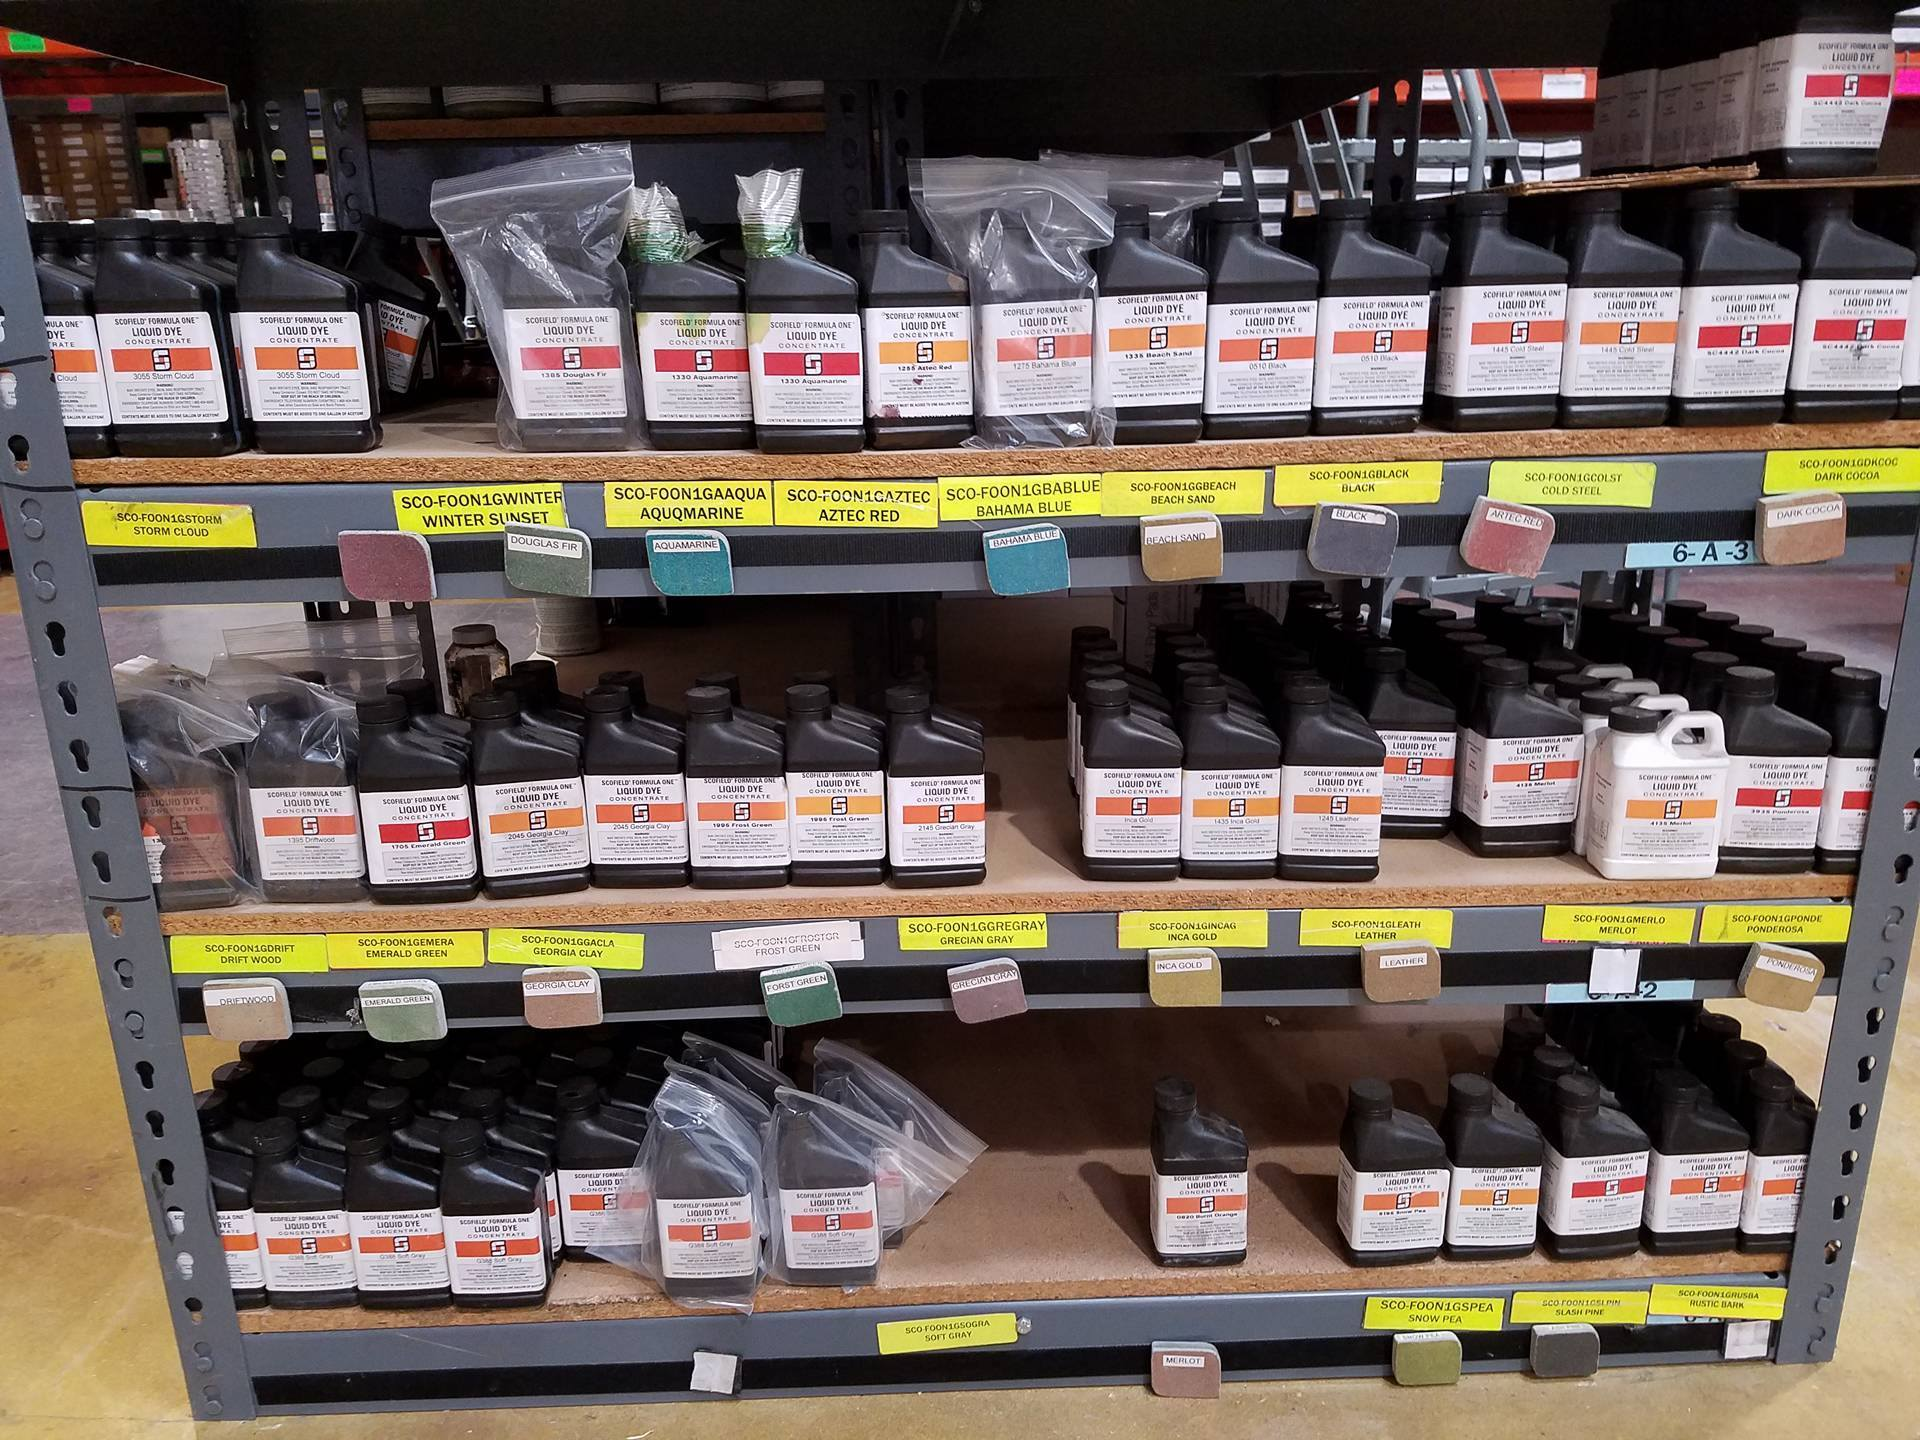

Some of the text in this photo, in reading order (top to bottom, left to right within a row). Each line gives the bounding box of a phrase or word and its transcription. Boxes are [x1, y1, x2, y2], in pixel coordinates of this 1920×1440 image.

[1133, 304, 1184, 316] LIQUID DYE
[1497, 300, 1546, 310] LIQUID DYE
[294, 316, 326, 324] FORMULA
[1358, 310, 1409, 321] LIQUID DYE
[900, 321, 947, 331] LIQUID DYE
[1019, 317, 1068, 328] LIQUID DYE
[131, 326, 182, 337] LIQUID DYE
[277, 326, 329, 337] LIQUID DYE
[676, 328, 727, 338] LIQUID DYE
[786, 331, 837, 341] LIQUID DYE
[269, 337, 336, 345] CONCENTRATE
[296, 372, 318, 380] Storm
[319, 372, 341, 380] Cloud
[1813, 470, 1881, 482] DARK COCOA
[1341, 482, 1376, 493] BLACK
[1541, 485, 1603, 496] COLD STEEL
[1150, 494, 1216, 506] BEACH SAND
[640, 506, 744, 521] AQUQMARINE
[976, 500, 1073, 516] BAHAMA BLUE
[1776, 505, 1841, 521] DARK COCOA
[423, 511, 549, 529] WINTER SUNSET
[818, 508, 900, 523] AZTEC RED
[1335, 509, 1367, 521] BLACK
[1523, 516, 1543, 528] RED
[133, 526, 209, 538] STORM CLOUD
[510, 535, 579, 552] DOUGLAS FIR
[992, 530, 1059, 547] BAHAMA BLUE
[1145, 532, 1206, 546] BEACH SAND
[653, 539, 718, 551] AQUAMARINE
[1701, 543, 1720, 562] A
[1215, 781, 1260, 791] LIQUID DYE
[1317, 778, 1364, 788] LIQUID DYE
[1652, 782, 1698, 791] LIQUID DYE
[616, 786, 663, 796] LIQUID DYE
[923, 787, 969, 797] LIQUID DYE
[283, 798, 330, 808] LIQUID DYE
[511, 792, 560, 804] LIQUID DYE
[397, 803, 448, 814] LIQUID DYE
[630, 823, 655, 831] Georgia
[656, 823, 671, 831] Clay
[411, 842, 442, 850] Emerald
[1599, 925, 1637, 936] MERLOT
[1746, 925, 1804, 934] PONDEROSA
[940, 935, 1014, 946] GRECIAN GRAY
[1167, 931, 1218, 942] INCA GOLD
[1354, 931, 1397, 940] LEATHER
[366, 948, 448, 960] EMERALD GREEN
[533, 946, 604, 959] GEORGIA CLAY
[755, 943, 821, 957] FROST GREEN
[220, 954, 282, 966] DRIFT WOOD
[1384, 957, 1424, 968] LEATHER
[1157, 961, 1203, 971] INCA GOLD
[1766, 958, 1817, 977] PONDEROSA
[525, 980, 591, 992] GEORGIA CLAY
[766, 975, 828, 993] FORST GREEN
[951, 970, 1018, 991] GRECIAN GRAY
[219, 994, 275, 1007] DRIFTWOOD
[364, 994, 432, 1008] EMERALD GREEN
[376, 1220, 421, 1230] LIQUID DYE
[474, 1224, 519, 1234] LIQUID DYE
[1688, 1299, 1745, 1309] RUSTIC BARK
[1555, 1307, 1604, 1317] SLASH PINE
[1408, 1313, 1463, 1325] SNOW PEA
[924, 1330, 973, 1343] SOFT GRAY
[1165, 1356, 1202, 1366] MERLOT
